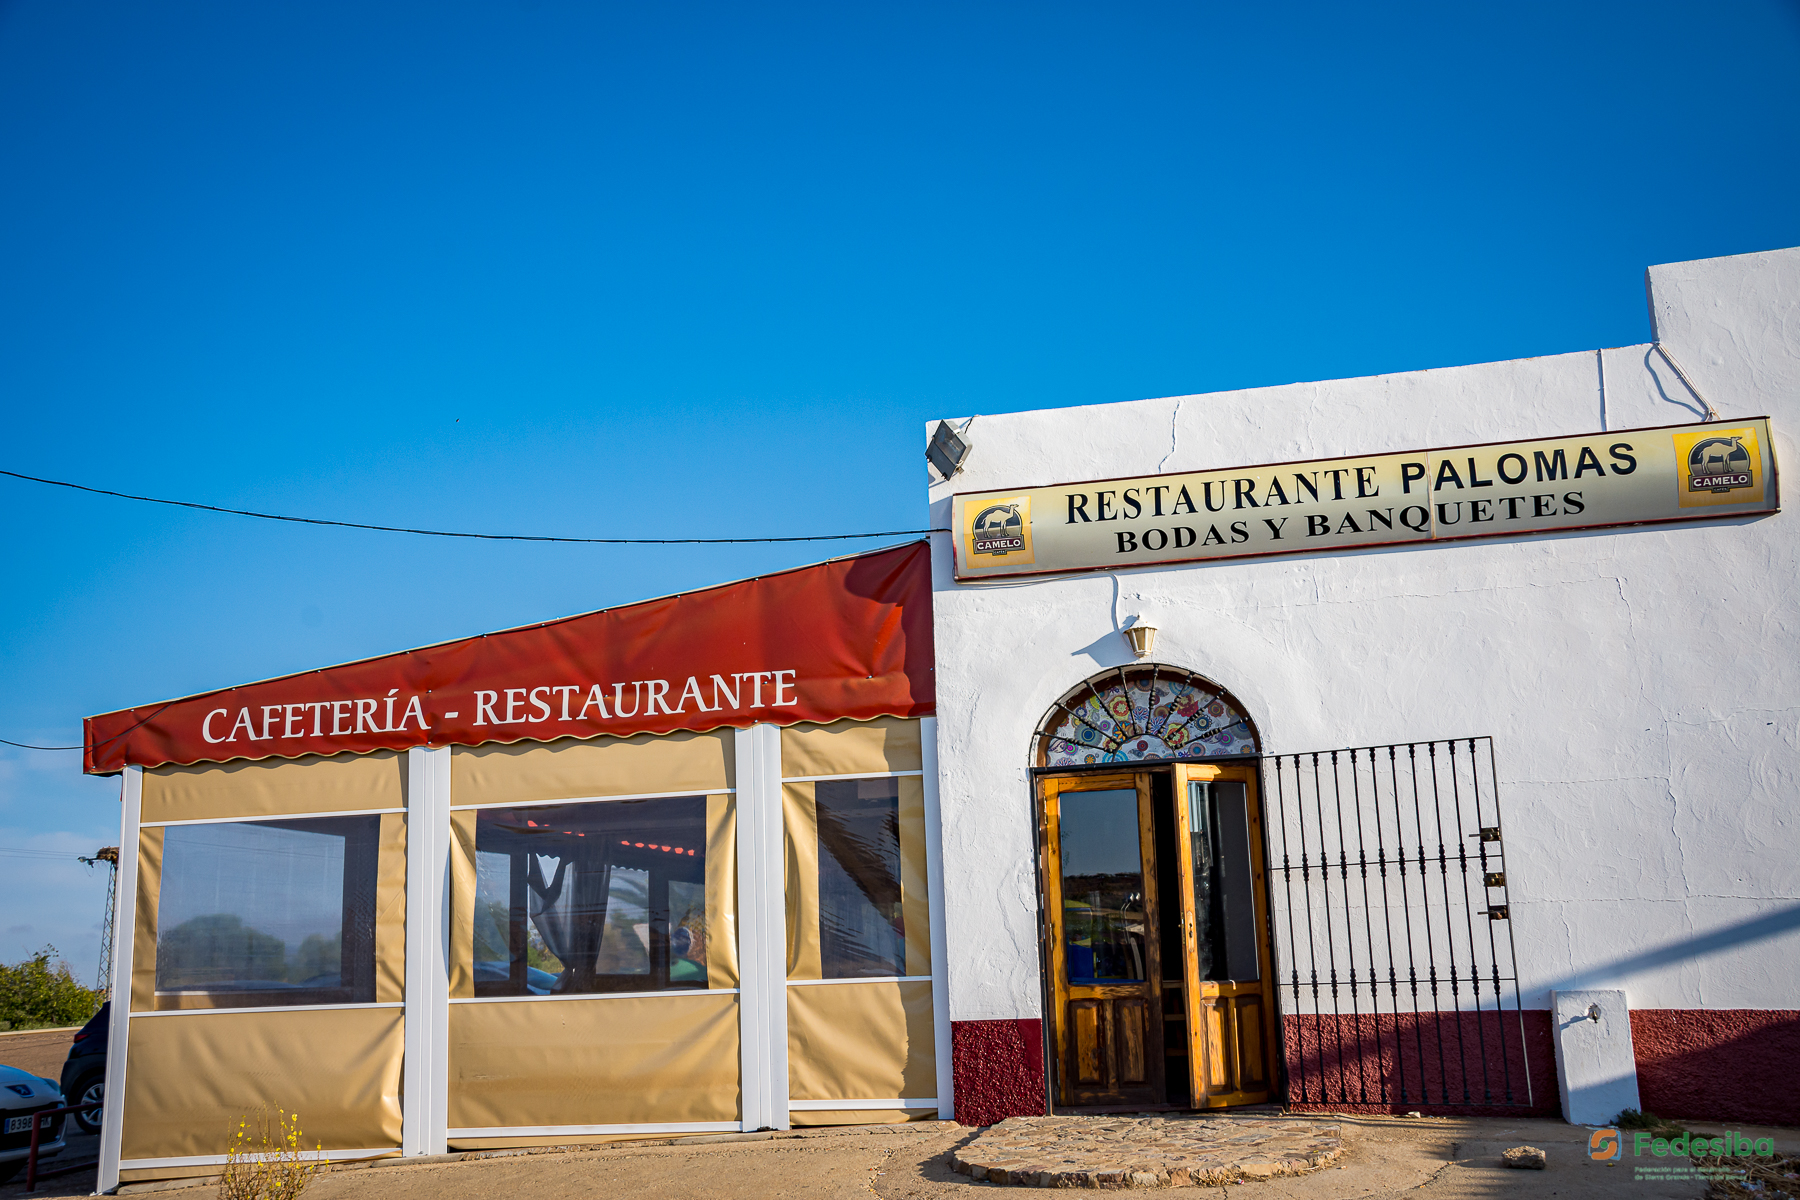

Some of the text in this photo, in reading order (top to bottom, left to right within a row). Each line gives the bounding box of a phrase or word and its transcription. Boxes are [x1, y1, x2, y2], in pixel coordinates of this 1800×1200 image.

[1065, 443, 1638, 524] RESTAURANTE PALOMAS
[1693, 475, 1748, 487] CAMELO
[1114, 491, 1586, 553] BODAS Y BANQUETES
[977, 539, 1021, 550] CAMELO
[202, 669, 798, 744] CAFETERÍA - RESTAURANTE
[10, 1117, 33, 1130] 8398
